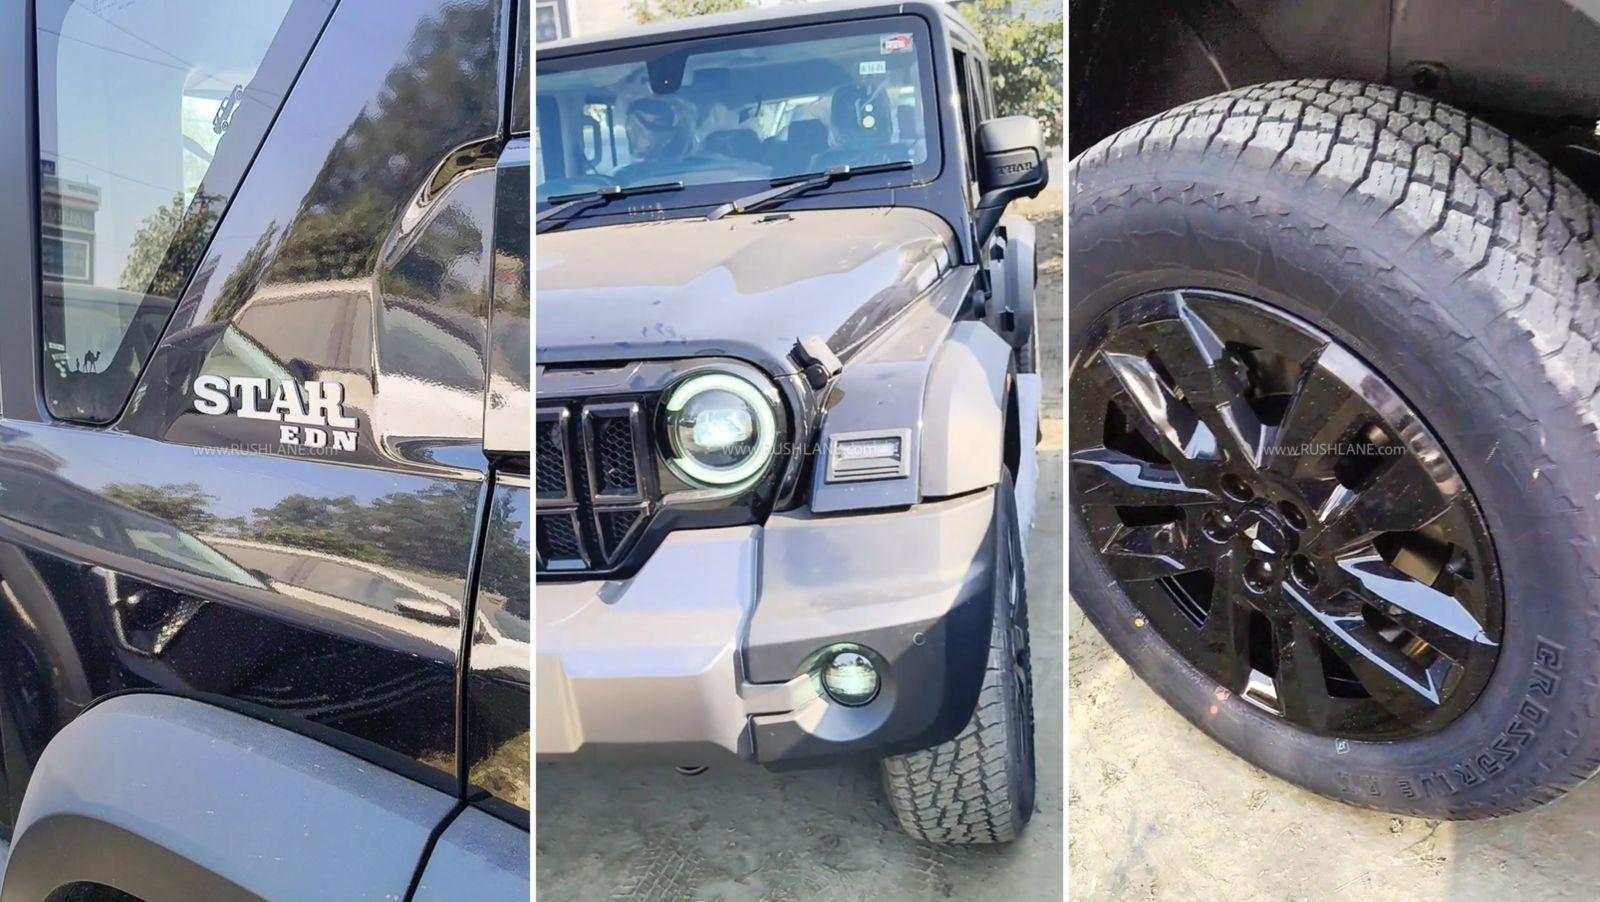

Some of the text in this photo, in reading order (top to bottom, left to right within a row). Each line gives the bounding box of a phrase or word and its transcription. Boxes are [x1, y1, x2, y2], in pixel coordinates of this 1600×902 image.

[193, 374, 359, 429] STAR
[279, 425, 359, 452] EDN
[1398, 634, 1565, 798] CROSSDRIVE
